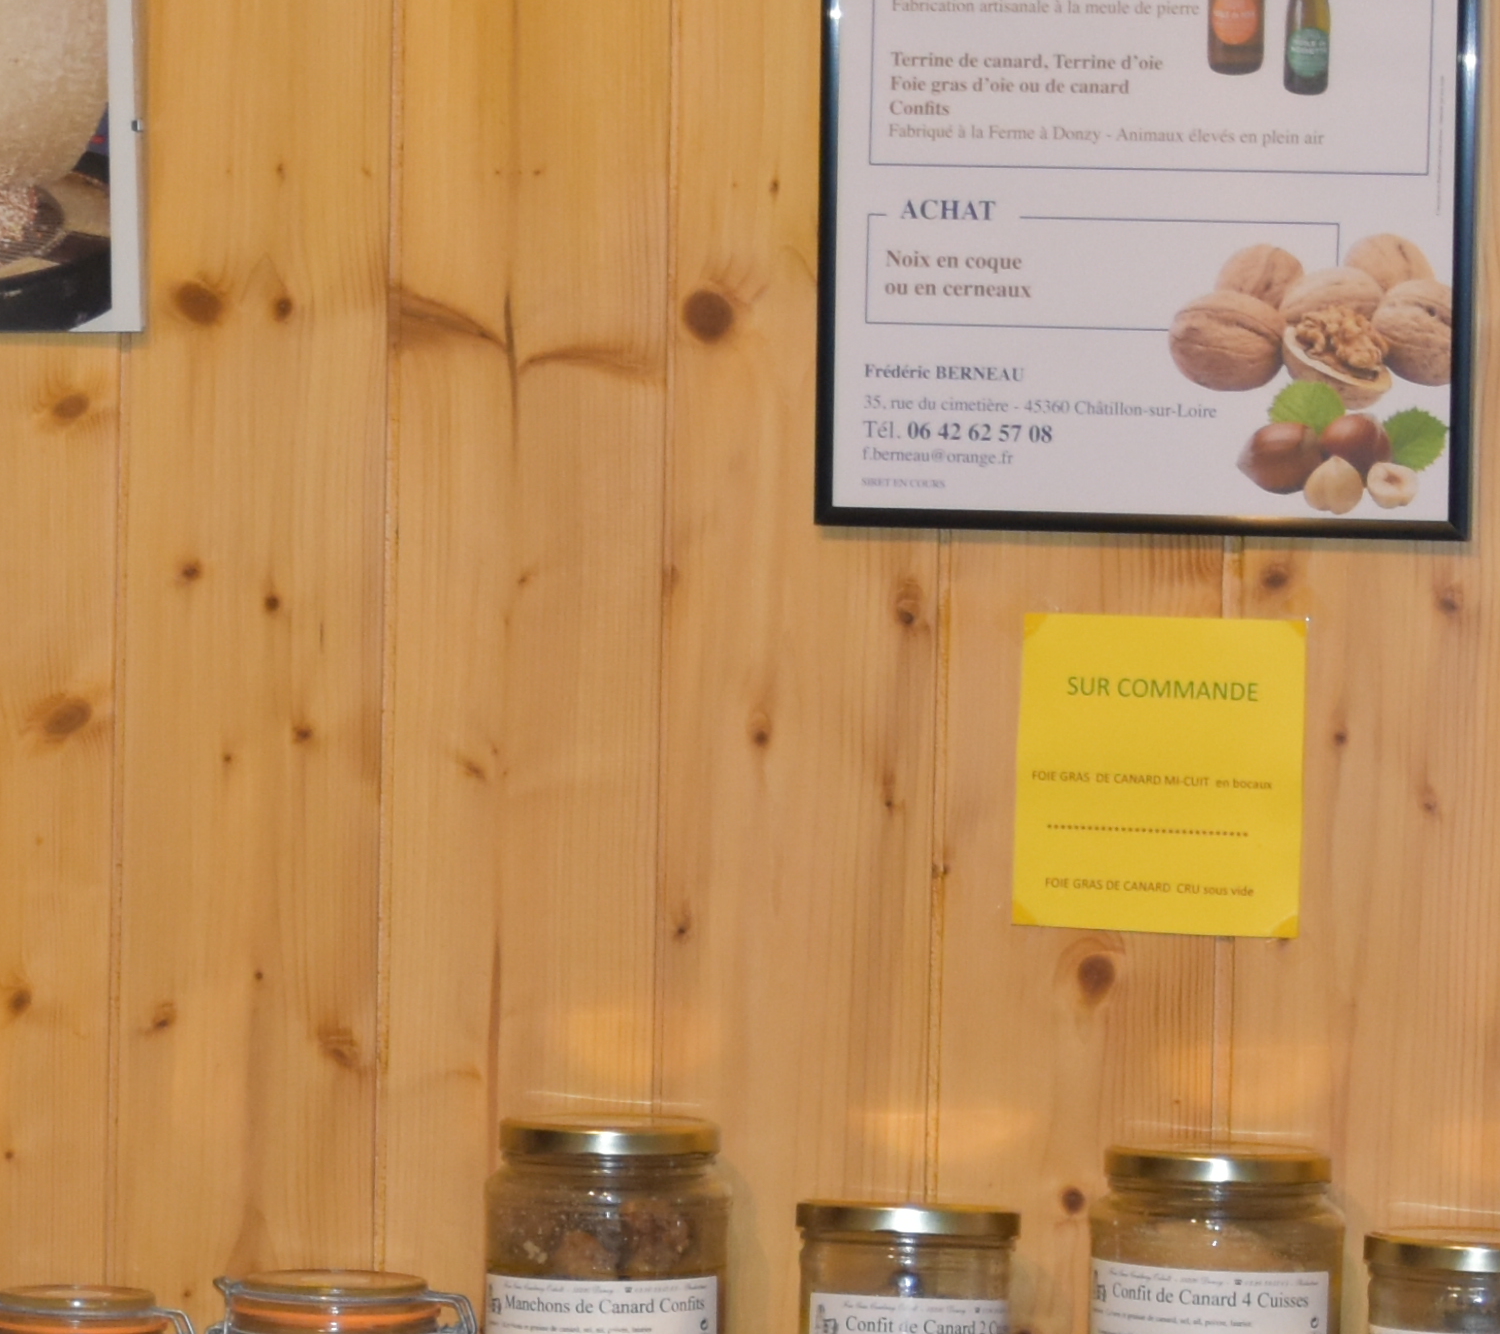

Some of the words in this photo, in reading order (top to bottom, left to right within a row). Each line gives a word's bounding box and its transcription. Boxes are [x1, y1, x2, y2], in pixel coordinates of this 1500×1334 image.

[890, 51, 953, 67] Terrine
[958, 52, 978, 67] de
[1053, 53, 1115, 69] Terrine
[891, 75, 926, 91] Foie
[931, 80, 967, 94] gras
[1019, 81, 1039, 93] ou
[1045, 78, 1064, 93] de
[1070, 78, 1129, 94] canard
[889, 100, 949, 115] Confits
[901, 199, 995, 220] ACHAT
[886, 250, 929, 267] Noix
[936, 256, 958, 268] en
[965, 256, 1022, 274] coque
[884, 282, 907, 295] ou
[914, 283, 936, 295] en
[942, 284, 1030, 298] cerneaux
[865, 363, 930, 379] Frédéric
[936, 365, 1023, 381] BERNEAU
[863, 420, 899, 438] Tél.
[907, 421, 930, 439] 06
[937, 422, 960, 440] 42
[968, 423, 991, 441] 62
[998, 424, 1021, 442] 57
[1028, 425, 1052, 443] 08
[1066, 675, 1109, 696] SUR
[1117, 677, 1258, 701] COMMANDE
[1031, 770, 1056, 781] FOIE
[1059, 770, 1090, 782] GRAS
[1095, 772, 1110, 783] DE
[1113, 773, 1161, 785] CANARD
[1164, 774, 1209, 787] MI-CUIT
[1215, 779, 1229, 788] en
[1232, 778, 1272, 790] bocaux
[1045, 877, 1069, 888] FOIE
[1072, 878, 1103, 890] GRAS
[1105, 879, 1120, 890] DE
[1123, 880, 1171, 893] CANARD
[1176, 882, 1200, 894] CRU
[1203, 886, 1228, 895] sous
[1230, 885, 1254, 896] vide
[504, 1294, 570, 1313] Manchons
[575, 1298, 593, 1313] de
[598, 1298, 654, 1314] Canard
[659, 1296, 706, 1313] Confits
[1112, 1282, 1151, 1301] Confit
[1156, 1287, 1173, 1303] de
[1178, 1288, 1236, 1307] Canard
[1241, 1291, 1251, 1307] 4
[1257, 1291, 1308, 1309] Cuisses
